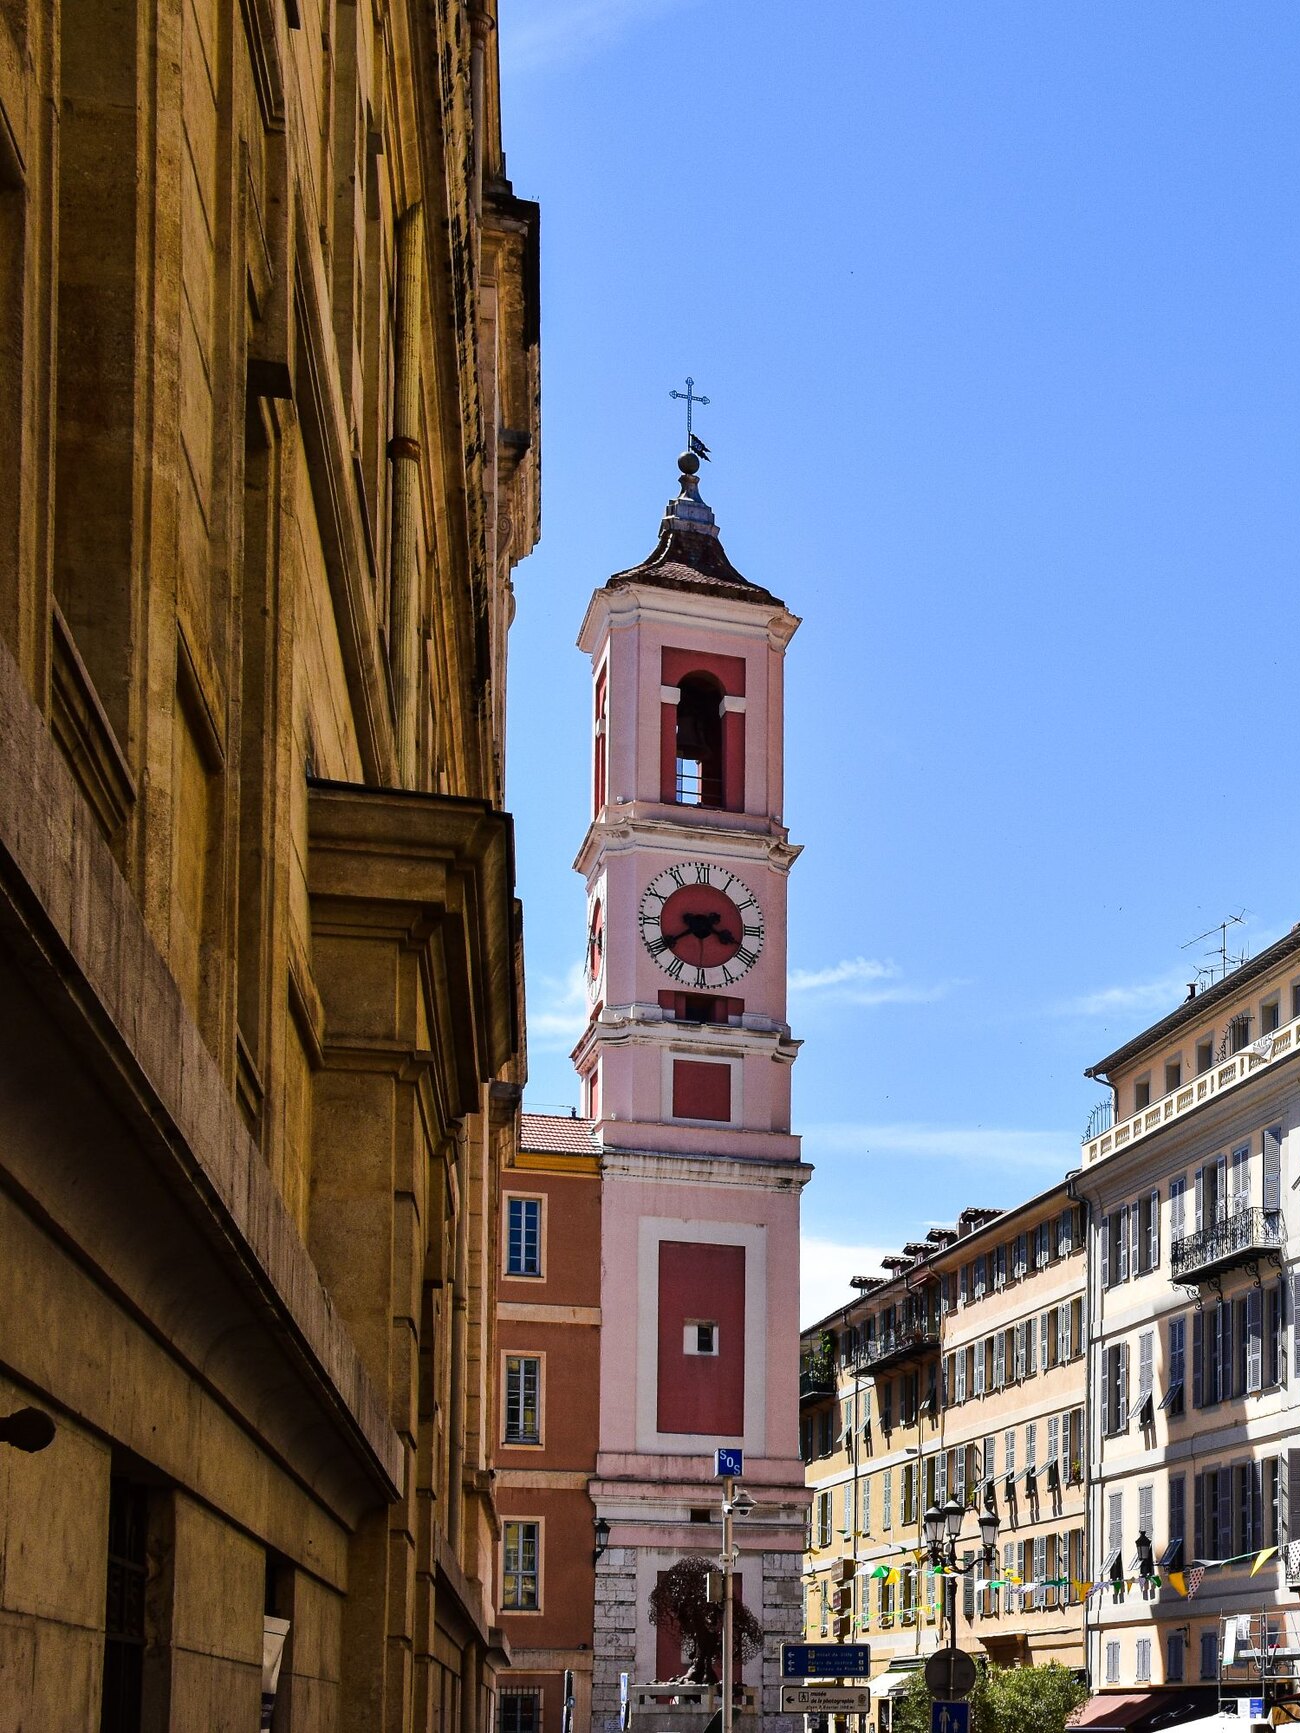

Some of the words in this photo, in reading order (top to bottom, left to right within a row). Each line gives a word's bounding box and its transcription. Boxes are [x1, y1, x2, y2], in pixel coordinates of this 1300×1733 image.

[669, 869, 686, 888] XI
[695, 866, 710, 885] XII
[722, 877, 733, 893] I
[649, 888, 667, 905] X
[737, 898, 755, 912] II
[642, 915, 660, 926] IX
[744, 925, 761, 937] III
[667, 957, 684, 980] VII
[722, 965, 734, 982] V
[720, 1449, 741, 1475] SOS
